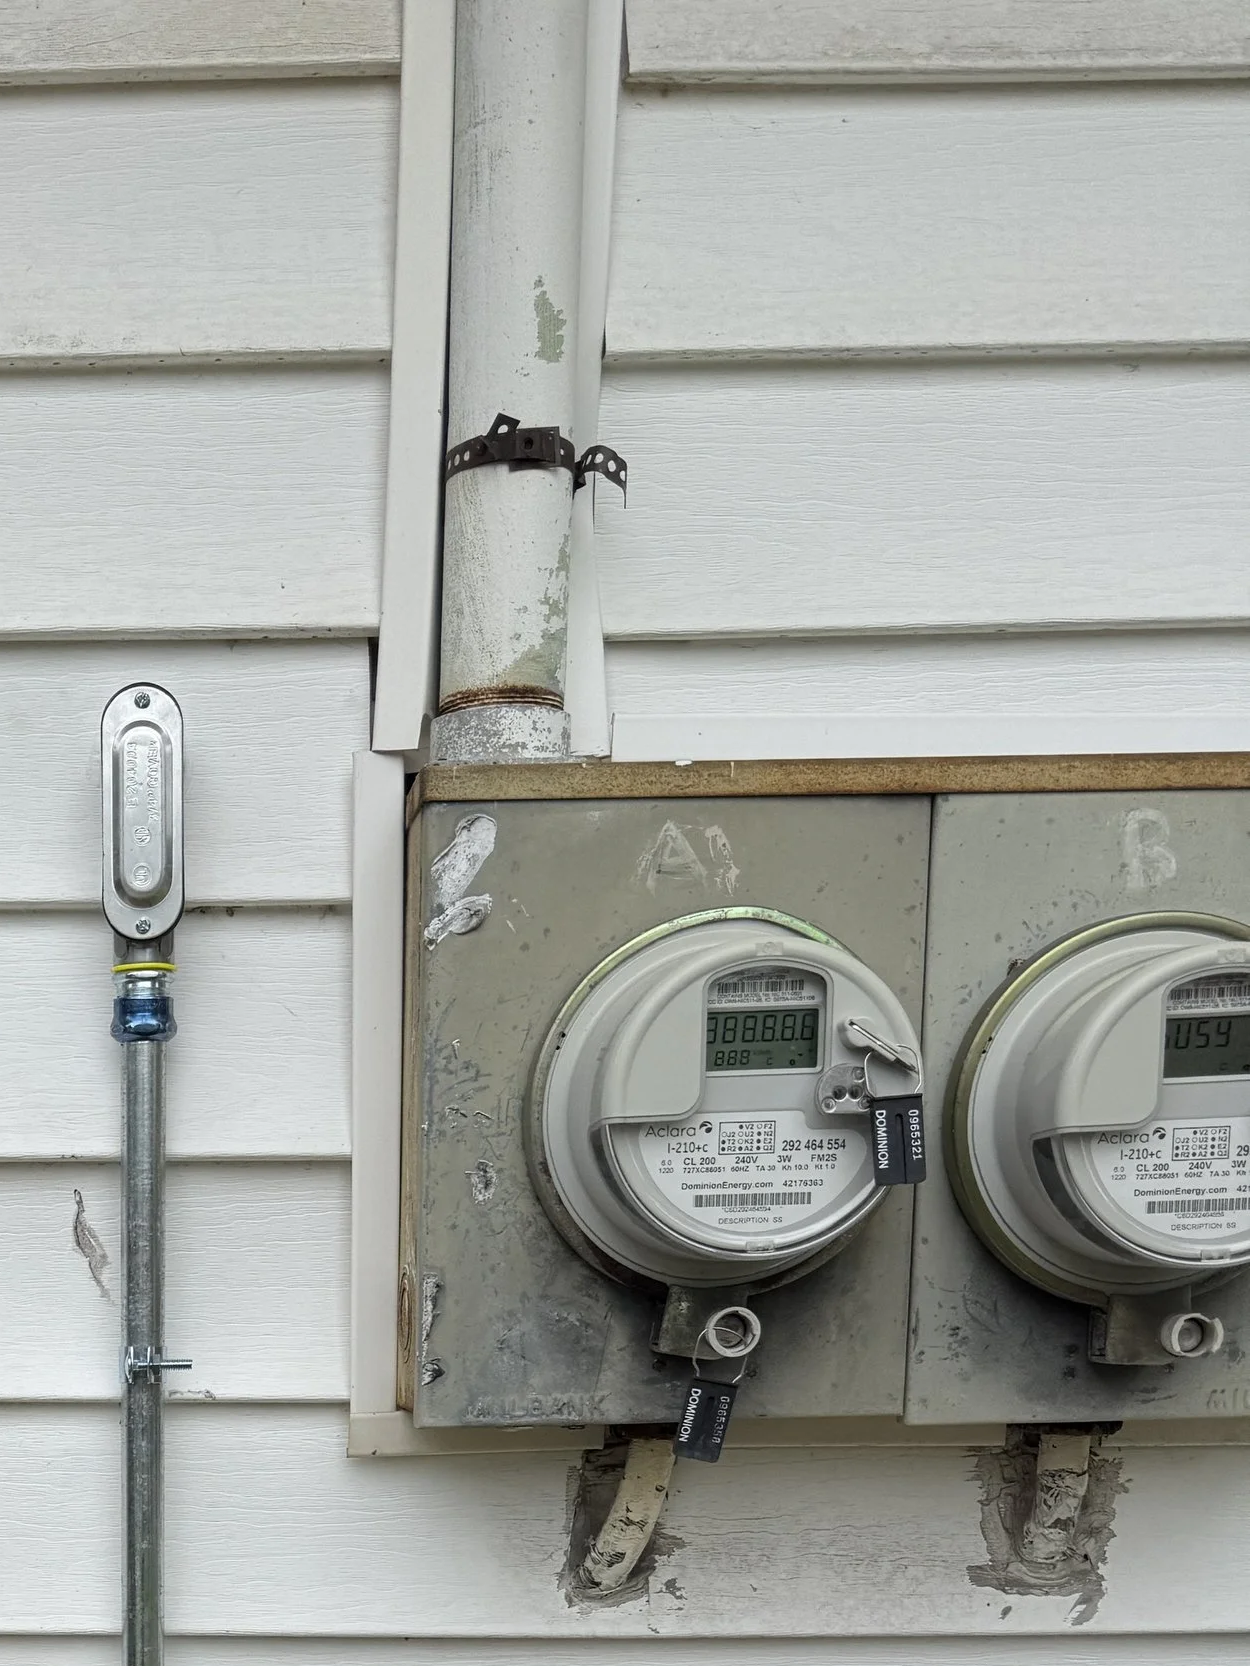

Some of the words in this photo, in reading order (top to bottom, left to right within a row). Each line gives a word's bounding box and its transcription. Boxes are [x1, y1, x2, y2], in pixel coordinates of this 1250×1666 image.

[645, 1124, 696, 1138] Aclara
[908, 1109, 922, 1160] 0965321
[875, 1110, 889, 1169] DOMINION
[1098, 1132, 1150, 1144] Aclara
[781, 1140, 801, 1151] 292
[804, 1139, 824, 1150] 464
[827, 1138, 846, 1150] 554
[700, 1157, 716, 1165] 200
[735, 1156, 758, 1164] 240V
[777, 1155, 792, 1163] 3W
[811, 1153, 837, 1162] FM2S
[1136, 1164, 1149, 1172] CL
[1152, 1163, 1170, 1171] 200
[1189, 1162, 1212, 1170] 240V
[1232, 1160, 1246, 1168] 3W
[681, 1180, 773, 1190] DominionEnergy.com
[1134, 1187, 1227, 1196] DominionEnergy.com
[1171, 1223, 1222, 1231] DESCRIPTION
[679, 1388, 701, 1442] DOMINION
